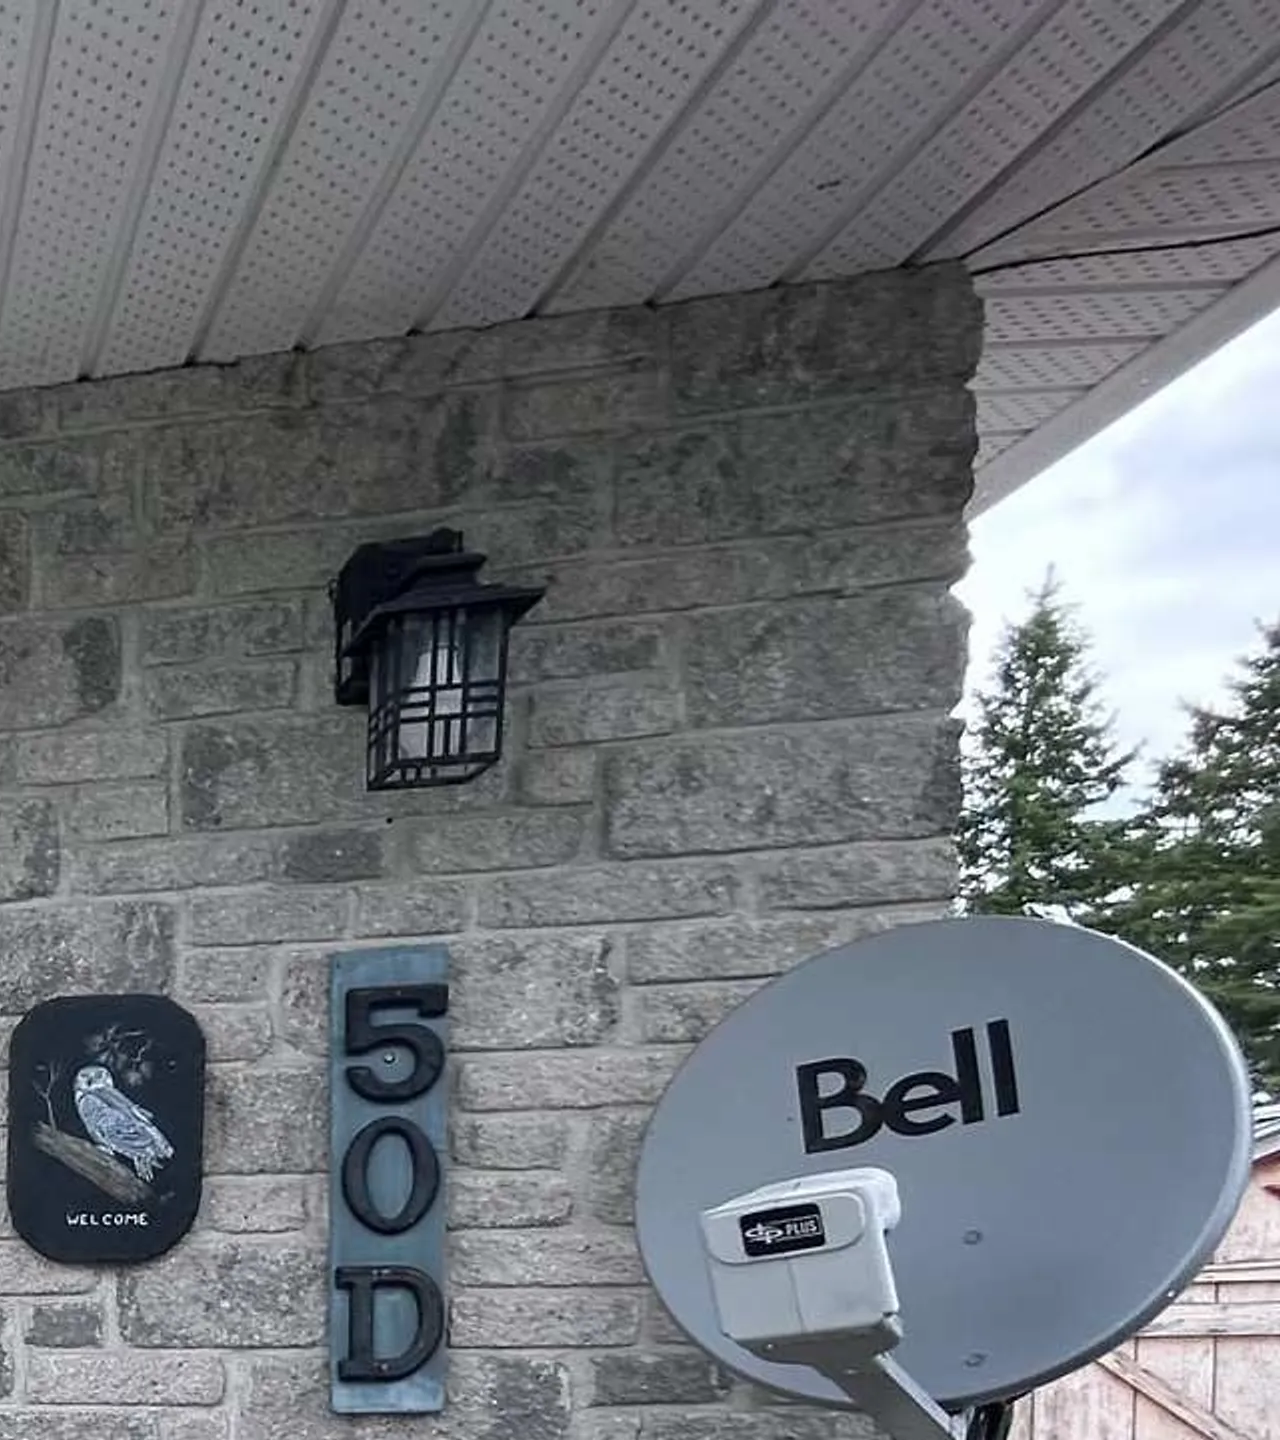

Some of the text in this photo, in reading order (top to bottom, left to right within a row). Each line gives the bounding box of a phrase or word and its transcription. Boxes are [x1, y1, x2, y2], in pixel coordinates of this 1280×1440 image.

[796, 1018, 1021, 1154] Bell
[65, 1212, 149, 1226] WELCOME
[785, 1220, 817, 1236] PLUS
